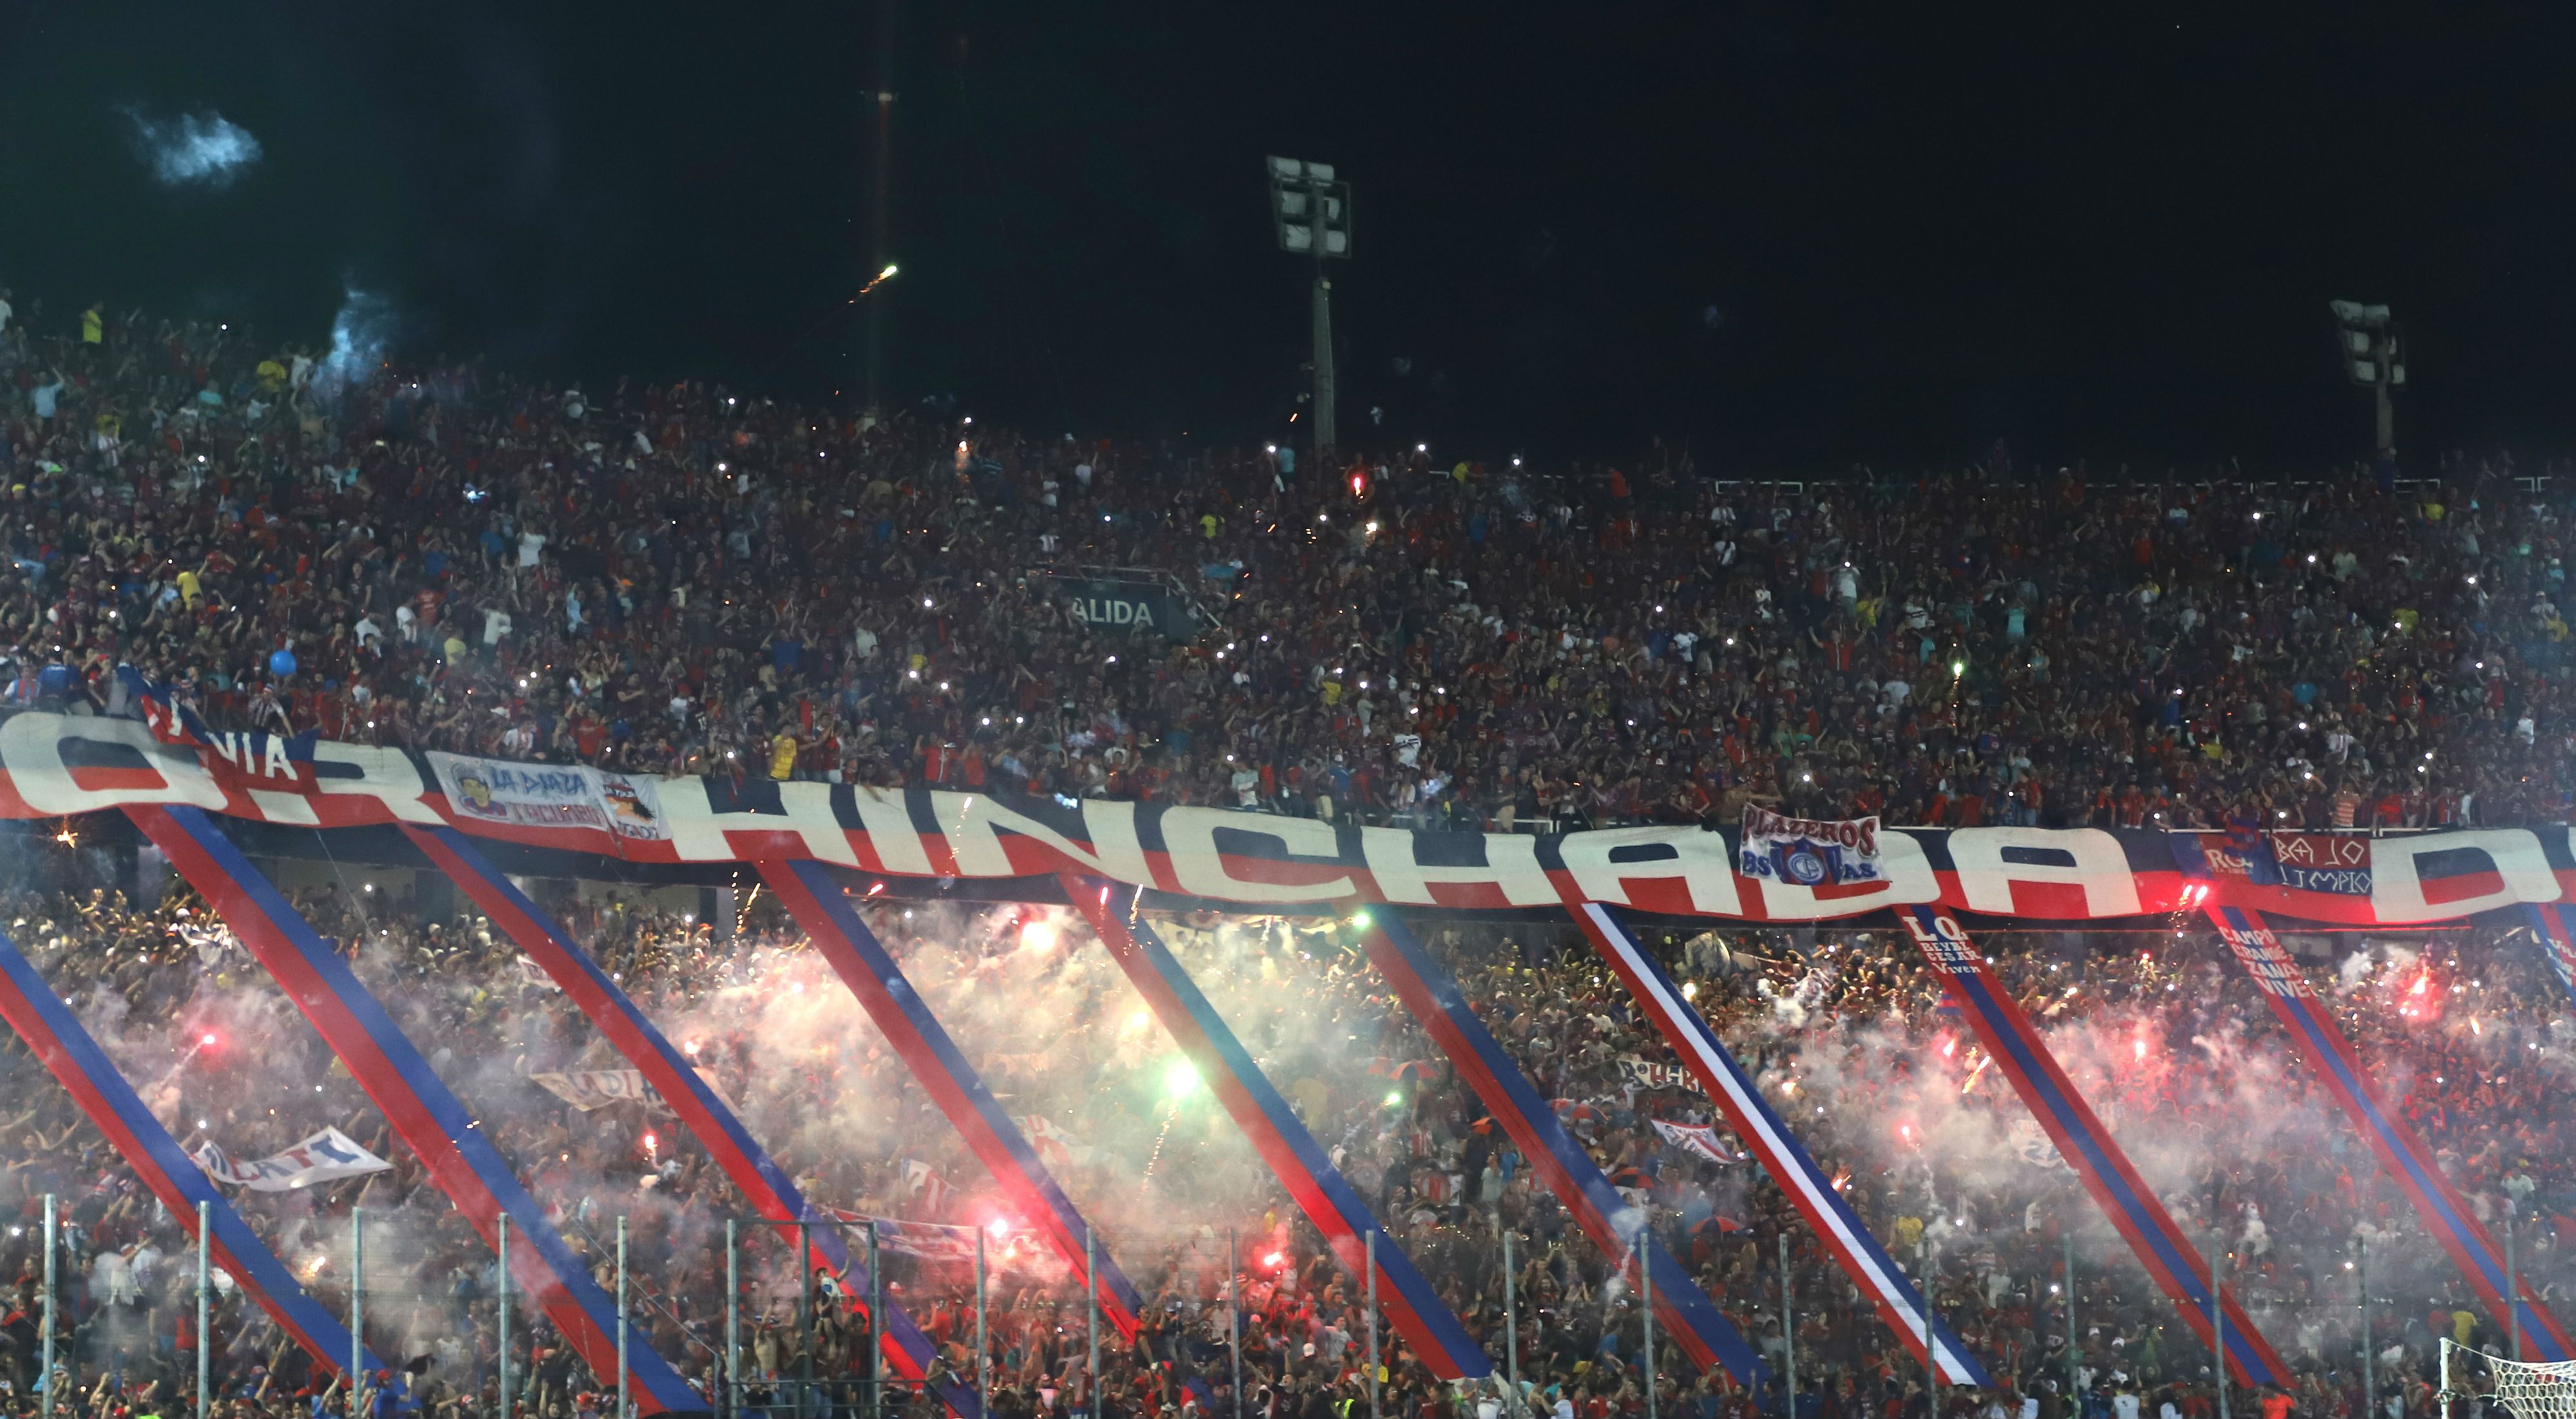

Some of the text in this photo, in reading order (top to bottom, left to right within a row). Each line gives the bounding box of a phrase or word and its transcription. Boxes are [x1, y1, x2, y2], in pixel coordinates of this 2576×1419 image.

[1071, 597, 1154, 626] ALIDA
[1742, 850, 1772, 876] BS
[2370, 827, 2576, 922] D
[2218, 926, 2276, 946] CAMPO
[1926, 951, 1983, 962] CESAR
[2253, 976, 2311, 998] VIVE
